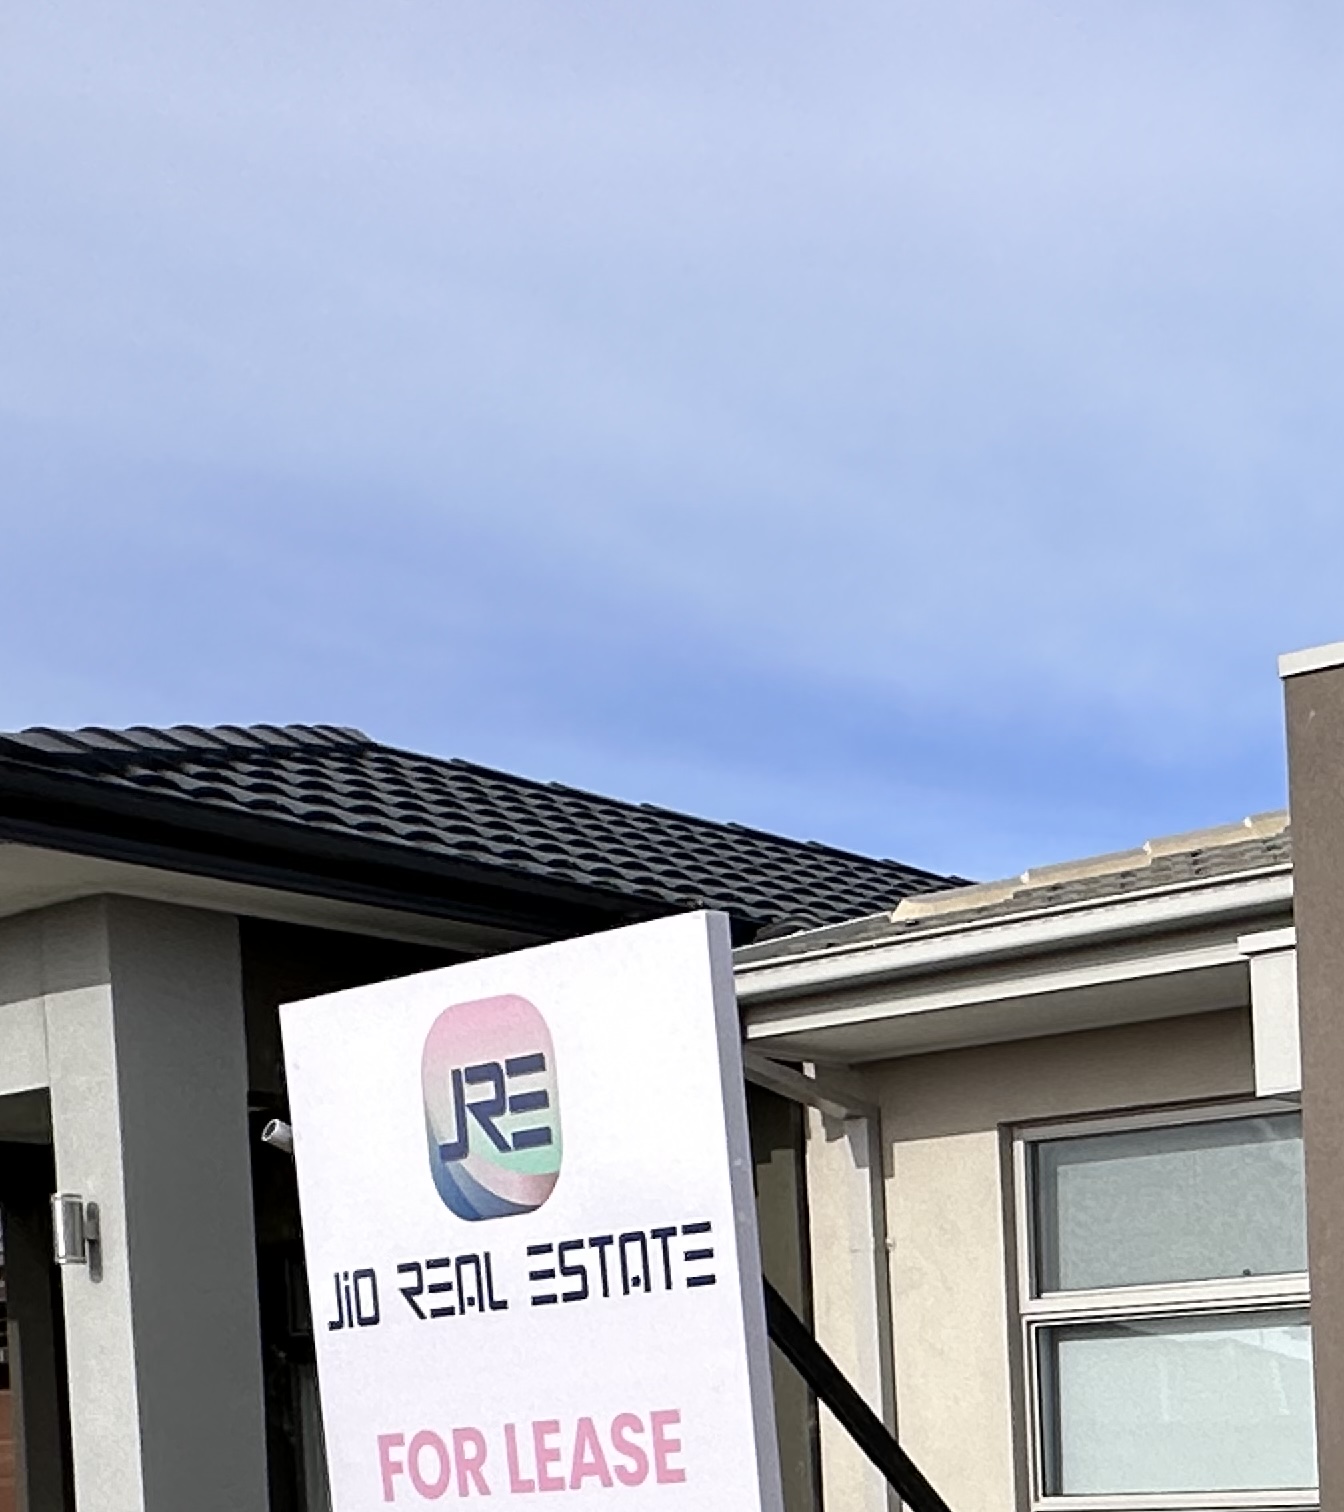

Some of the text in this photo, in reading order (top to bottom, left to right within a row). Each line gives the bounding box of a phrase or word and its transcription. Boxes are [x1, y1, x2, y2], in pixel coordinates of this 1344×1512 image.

[438, 1052, 553, 1163] JRE
[397, 1251, 509, 1320] REAL
[526, 1221, 717, 1306] ESTATE
[377, 1409, 687, 1502] FOR LEASE
